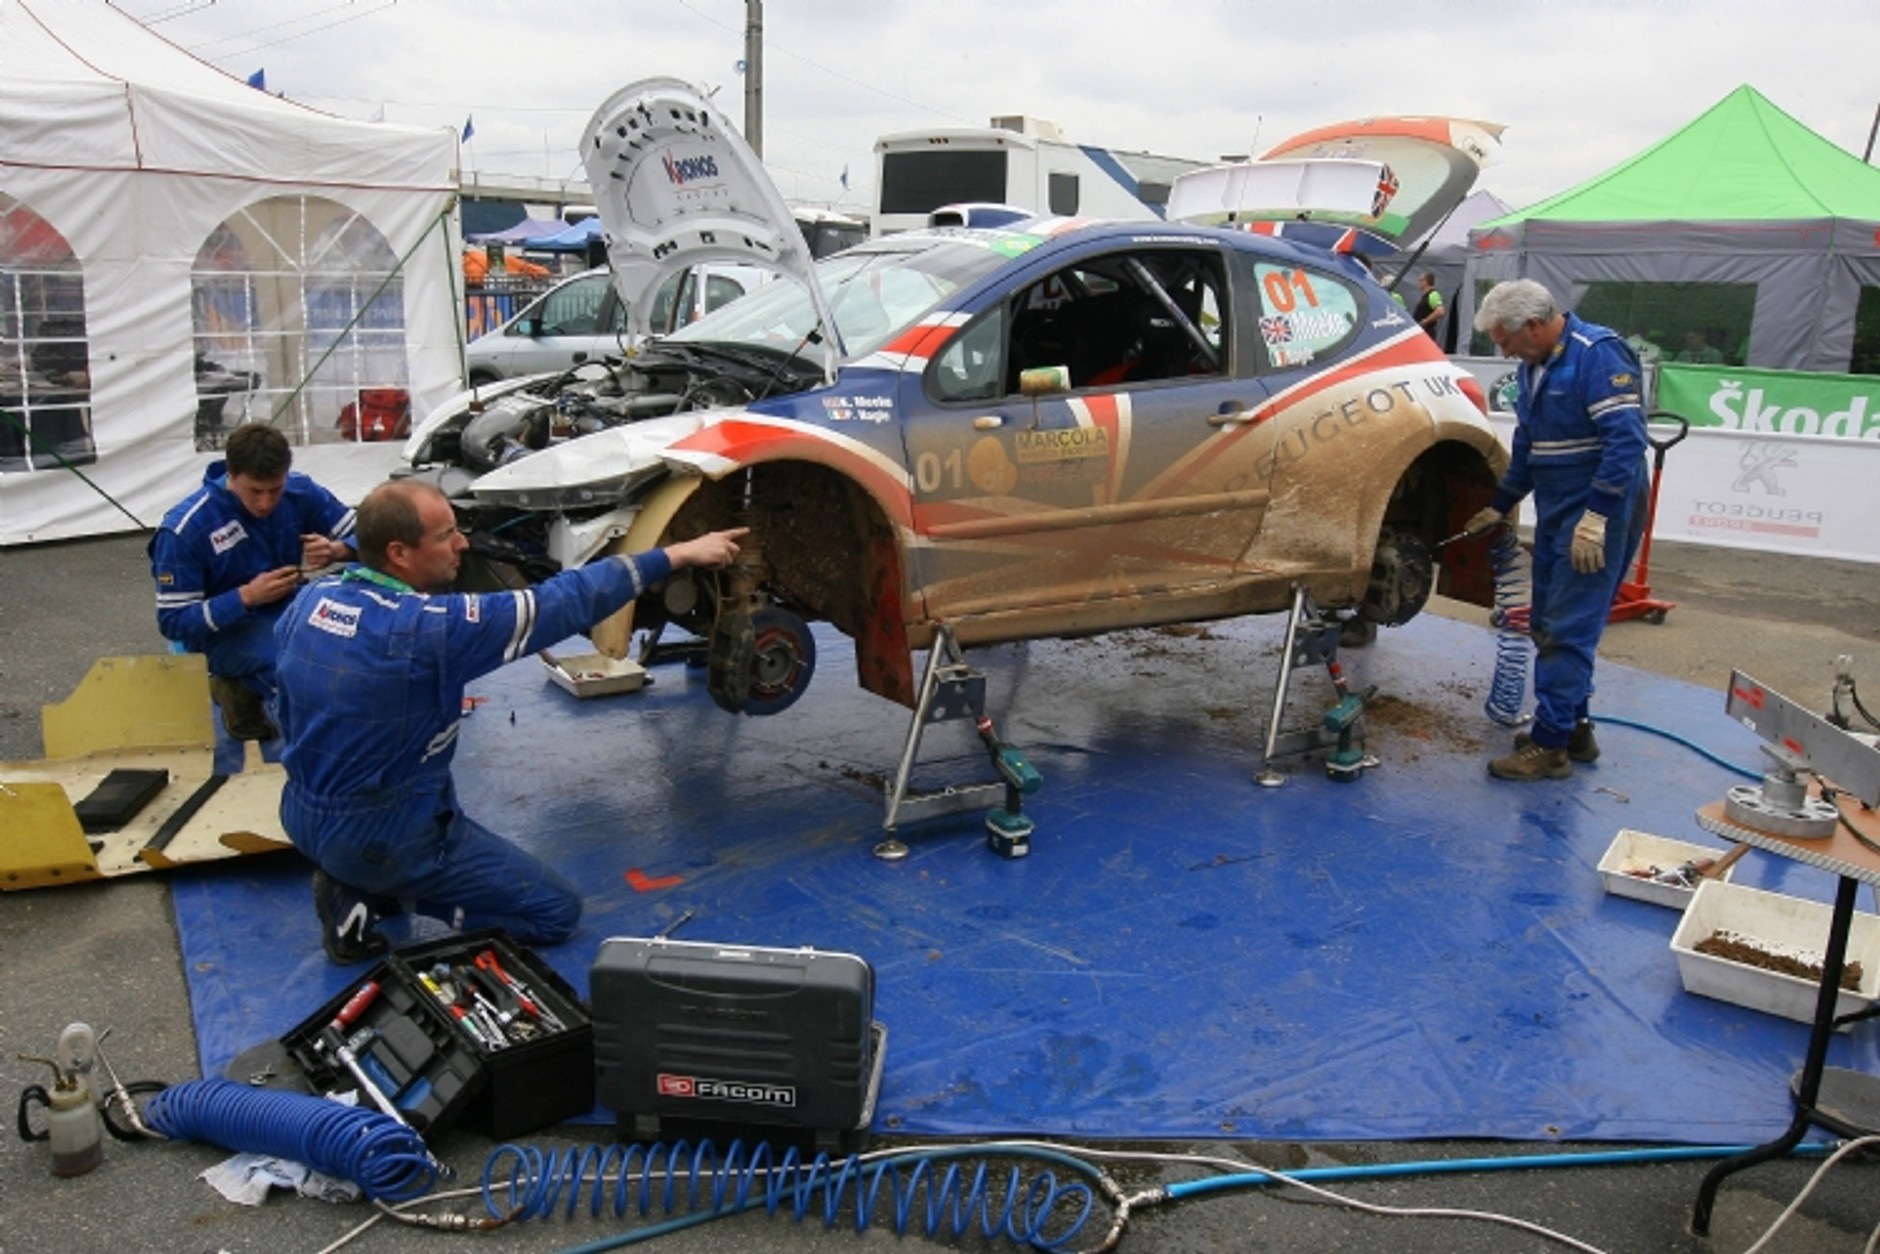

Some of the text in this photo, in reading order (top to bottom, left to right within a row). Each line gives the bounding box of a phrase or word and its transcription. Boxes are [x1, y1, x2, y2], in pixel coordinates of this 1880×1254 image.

[662, 148, 719, 185] KRONOS
[1263, 267, 1320, 313] 01
[1424, 375, 1461, 398] UK
[1224, 380, 1416, 492] PEUGEOT
[916, 449, 963, 493] 01
